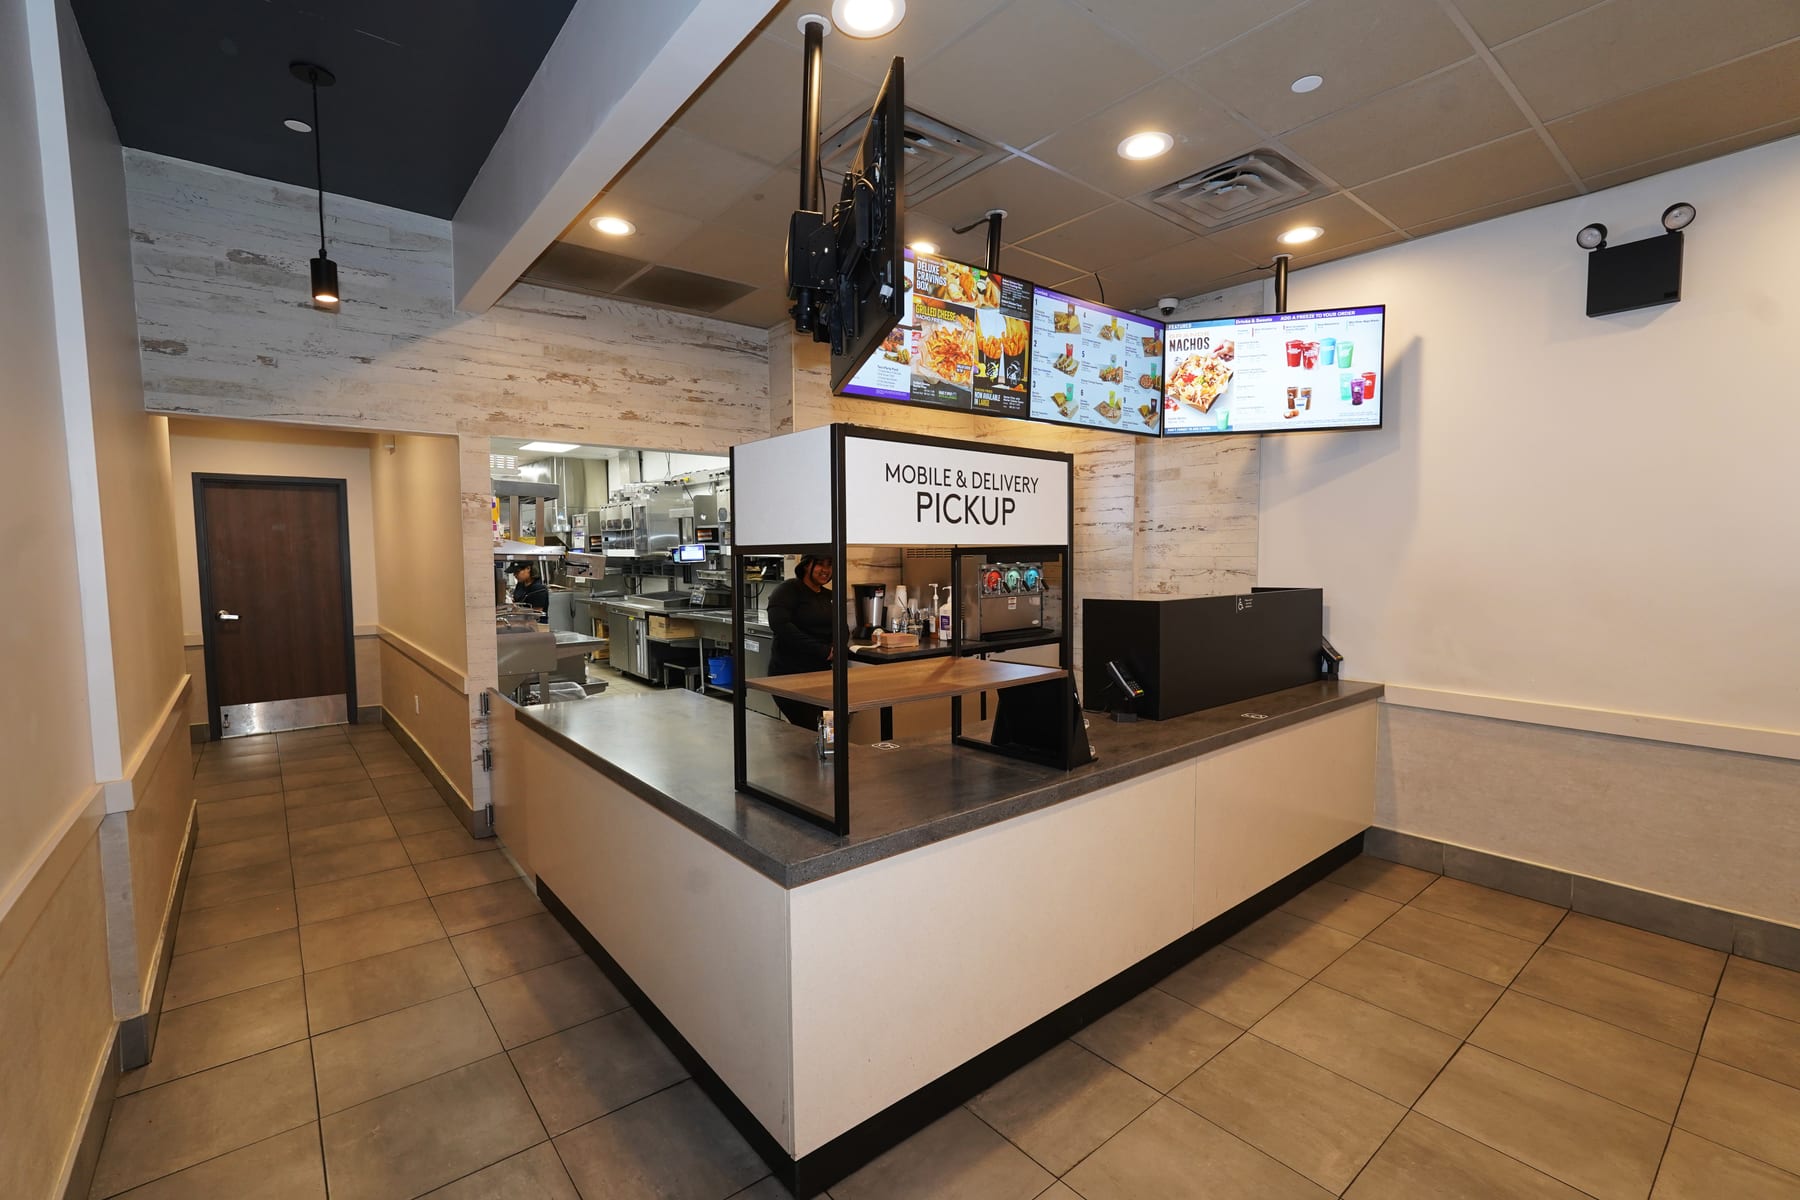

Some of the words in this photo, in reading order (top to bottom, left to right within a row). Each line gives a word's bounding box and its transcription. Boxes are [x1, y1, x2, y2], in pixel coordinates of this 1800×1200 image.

[917, 260, 940, 274] DELUXE
[917, 270, 947, 286] CRAVINGS
[917, 280, 929, 292] BOX
[915, 303, 937, 317] GRILLED
[937, 309, 957, 321] CHEESE
[1169, 336, 1210, 352] NACHOS
[885, 463, 952, 488] MOBILE
[956, 470, 968, 488] &
[972, 471, 1039, 494] DELIVERY
[916, 491, 1016, 526] PICKUP
